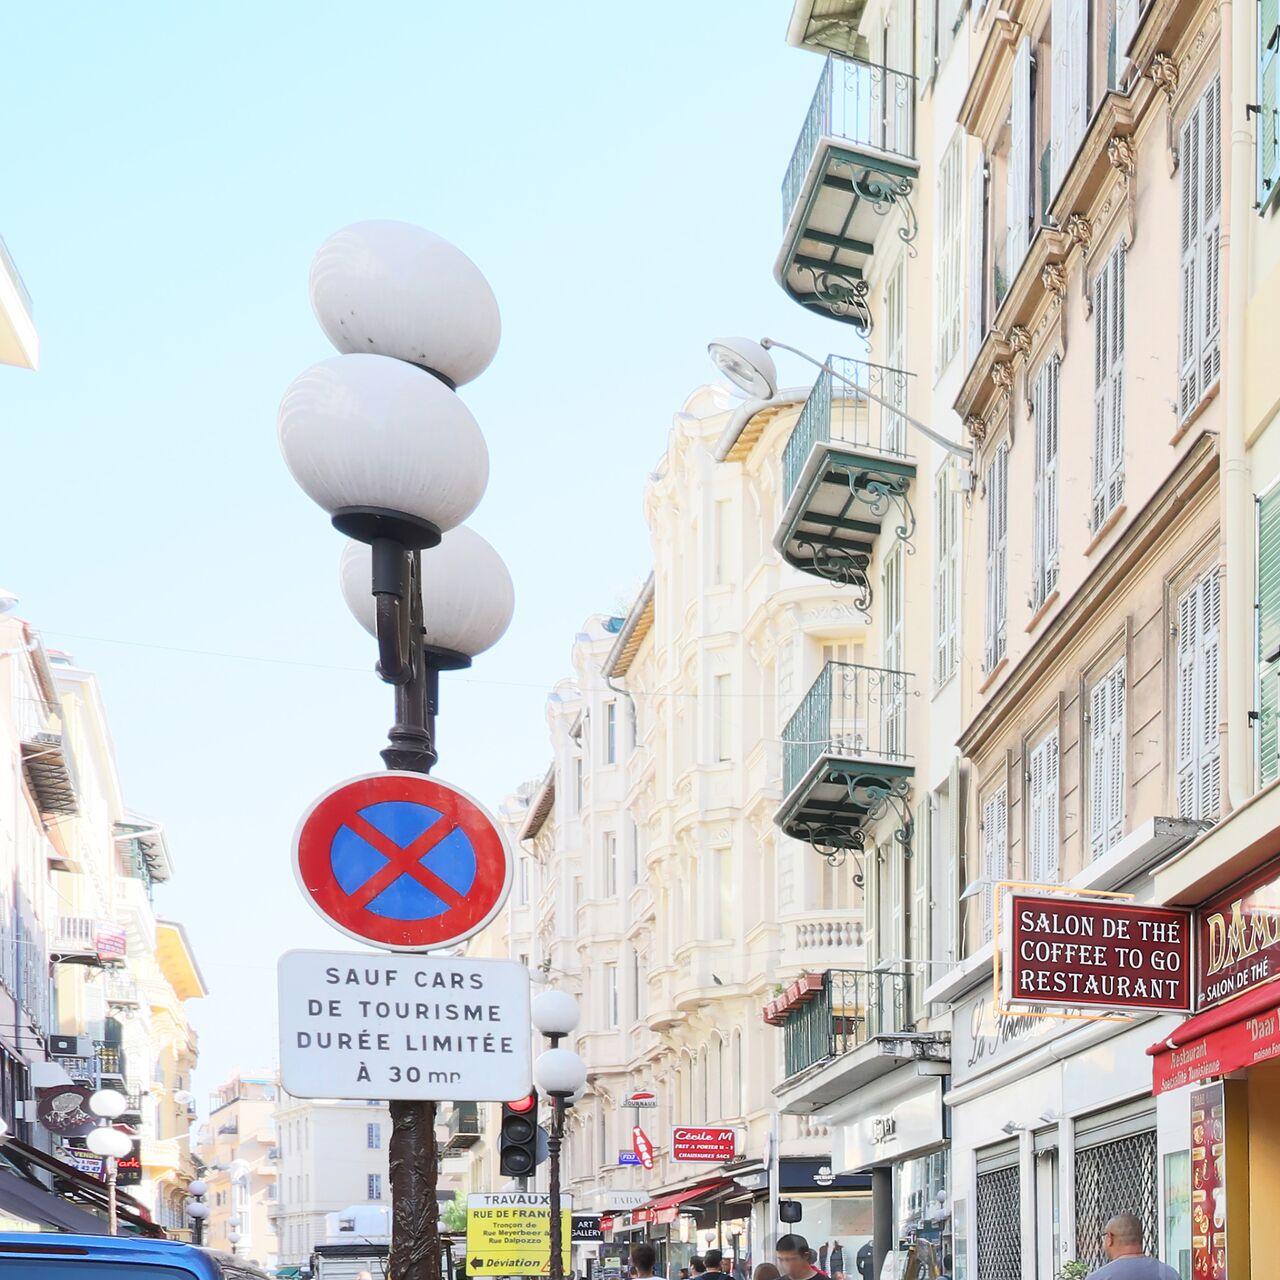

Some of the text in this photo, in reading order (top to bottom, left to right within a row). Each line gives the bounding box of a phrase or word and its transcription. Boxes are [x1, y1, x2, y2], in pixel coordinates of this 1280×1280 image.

[1020, 911, 1181, 943] SALON DE THÉ
[1020, 940, 1181, 972] COFFEE TO GO
[326, 967, 484, 990] SAUF CARS
[1020, 969, 1180, 1000] RESTAURANT
[1206, 956, 1269, 1001] SALON DE THÉ
[308, 999, 501, 1022] DE TOURISME
[297, 1029, 514, 1053] DURÉE LIMITÉE
[356, 1061, 371, 1082] À
[633, 1127, 653, 1168] TABAC
[718, 1132, 733, 1141] M
[484, 1195, 551, 1205] TRAVAUX
[473, 1210, 493, 1219] RUE
[496, 1210, 510, 1218] DE
[498, 1229, 542, 1238] Meyerbeer
[504, 1237, 542, 1245] Dalpozzo
[571, 1229, 602, 1237] GALLERY
[486, 1258, 541, 1267] Déviation
